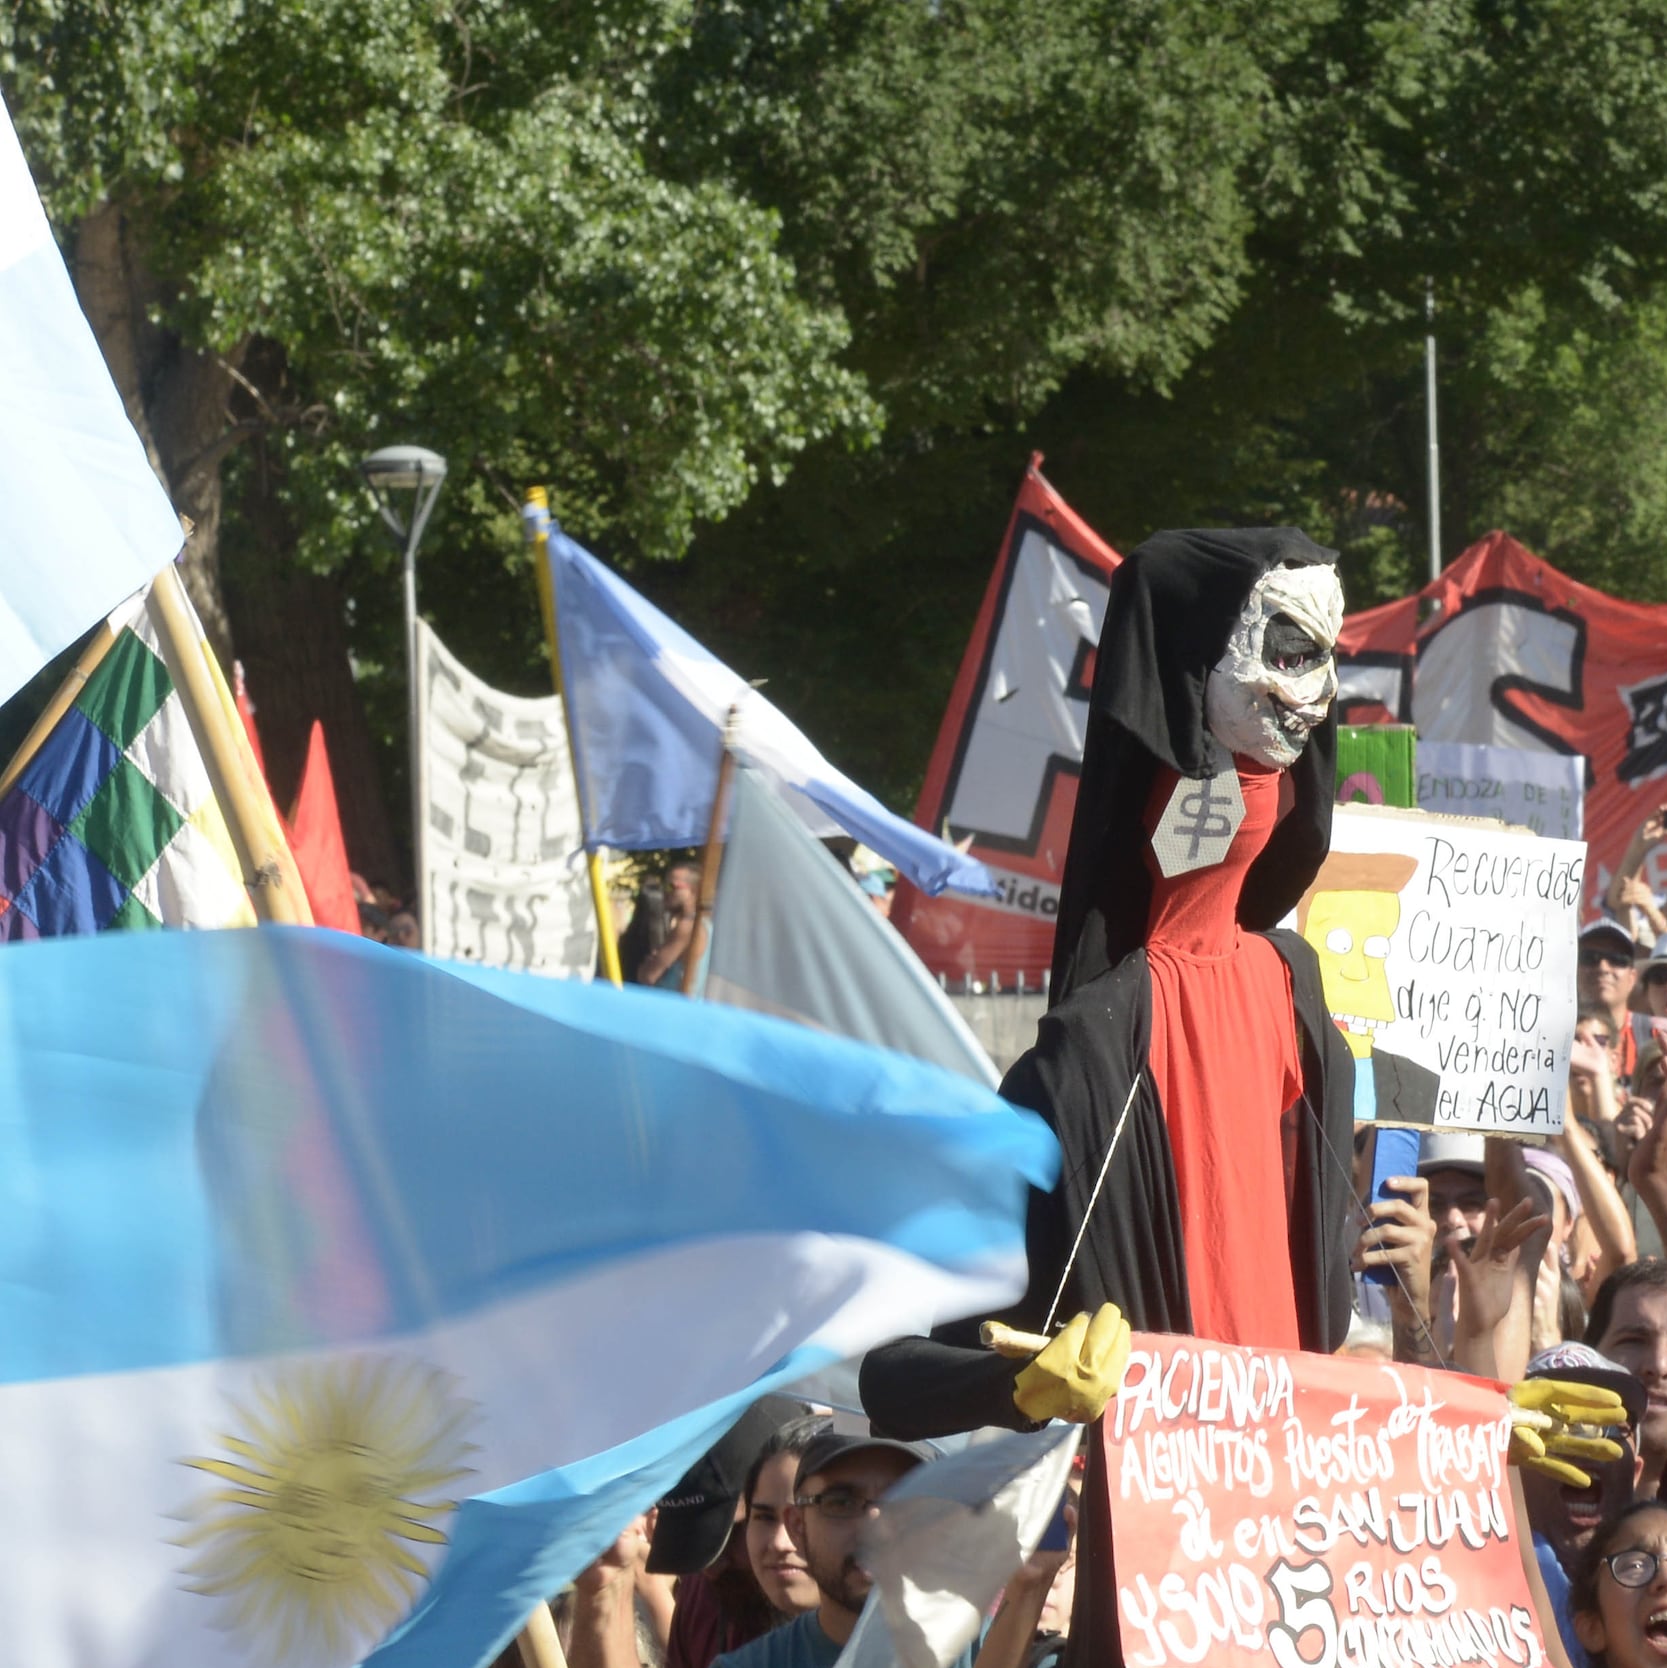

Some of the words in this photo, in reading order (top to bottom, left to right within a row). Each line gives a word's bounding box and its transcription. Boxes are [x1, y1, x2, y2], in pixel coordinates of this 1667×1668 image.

[1425, 837, 1582, 909] Recuerdas
[1408, 910, 1544, 974] Cuando
[1499, 987, 1542, 1033] NO
[1113, 1350, 1294, 1438] PACIENCIA
[1233, 1515, 1297, 1557] en
[1292, 1487, 1387, 1556] SAN
[1387, 1486, 1509, 1553] JUAN
[1342, 1555, 1457, 1617] RIOS
